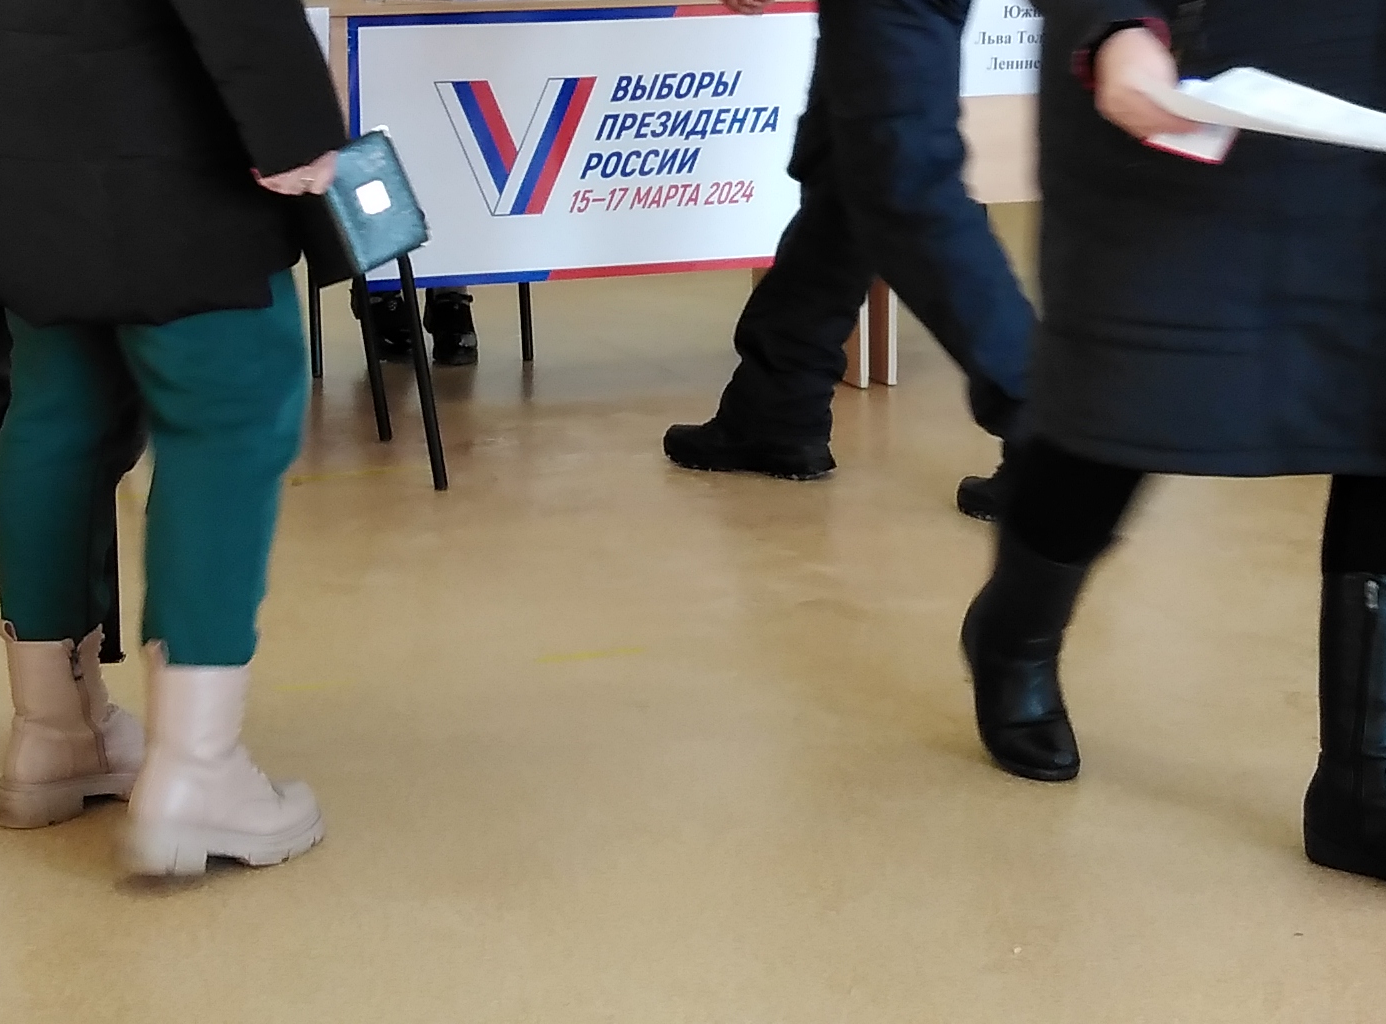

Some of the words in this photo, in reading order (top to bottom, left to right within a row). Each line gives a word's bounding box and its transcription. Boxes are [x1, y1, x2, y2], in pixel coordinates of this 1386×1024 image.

[974, 31, 1011, 45] Льва
[610, 70, 742, 102] ВЫБОРЫ
[594, 106, 780, 141] ПРЕЗИДЕНТА
[580, 147, 701, 179] РОССИИ
[629, 183, 702, 210] МАРТА
[703, 180, 755, 206] 2024
